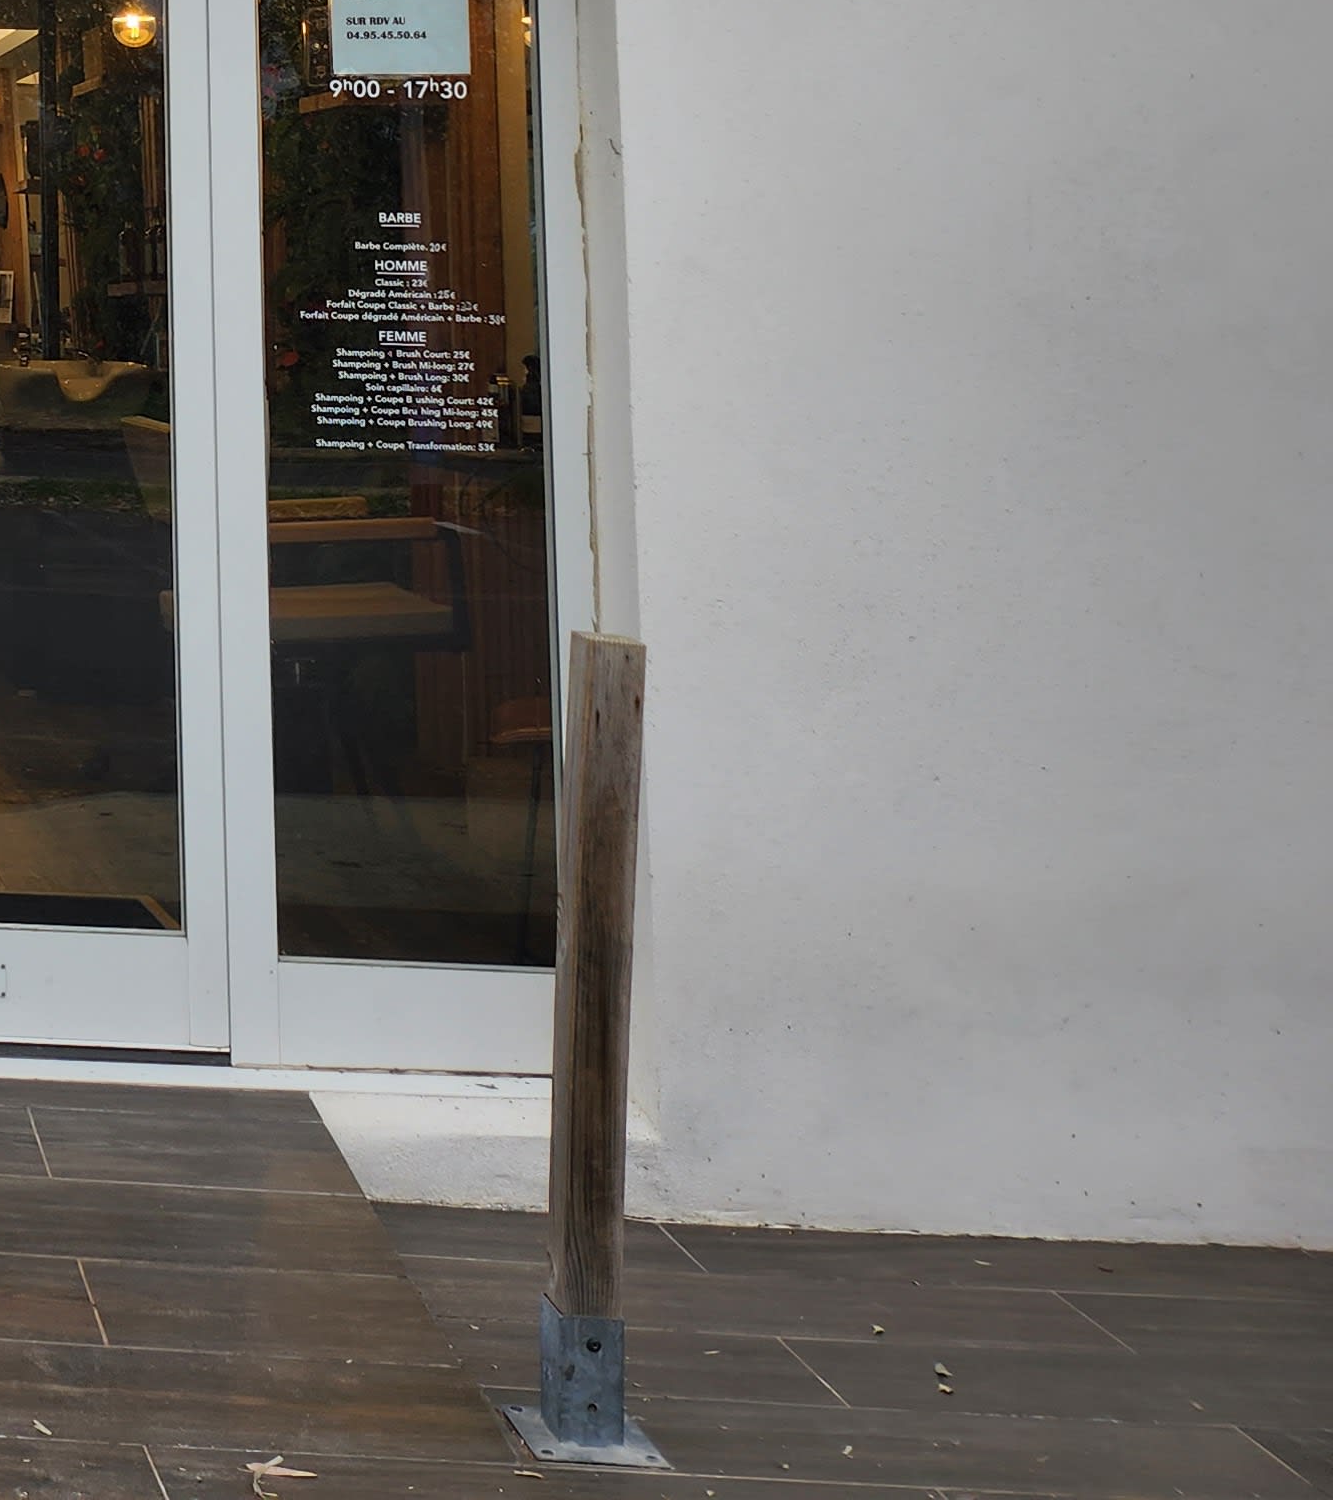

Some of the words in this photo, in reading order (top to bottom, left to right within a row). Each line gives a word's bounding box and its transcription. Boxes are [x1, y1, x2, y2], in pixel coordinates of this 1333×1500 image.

[346, 17, 366, 25] SUR
[369, 17, 390, 25] RDV
[392, 17, 405, 25] AU
[346, 31, 426, 39] 04.95.45.50.64
[329, 80, 380, 98] 9h00
[403, 79, 467, 99] 17h30
[378, 212, 421, 224] BARBE
[354, 242, 380, 250] Barbe
[375, 260, 428, 271] HOMME
[375, 279, 404, 287] Classic
[348, 289, 386, 299] Dégradé
[388, 291, 432, 299] Américain
[326, 300, 355, 308] Forfait
[357, 301, 386, 310] Coupe
[388, 301, 417, 310] Classic
[429, 302, 454, 310] Barbe
[300, 311, 329, 319] Forfait
[331, 312, 359, 321] Coupe
[362, 312, 398, 322] dégradé
[401, 313, 444, 321] Américain
[455, 314, 482, 322] Barbe
[378, 331, 427, 342] FEMME
[336, 348, 385, 359] Shampoing
[423, 350, 451, 358] Court:
[453, 351, 470, 359] 25€
[333, 360, 381, 370] Shampoing
[392, 361, 417, 369] Brush
[458, 362, 475, 370] 27€
[338, 371, 387, 381] Shampoing
[398, 372, 423, 380] Brush
[425, 373, 450, 383] Long:
[452, 373, 469, 382] 30€
[365, 383, 385, 391] Soin
[387, 384, 429, 393] capillaire:
[315, 393, 364, 404] Shampoing
[375, 395, 404, 405] Coupe
[447, 396, 475, 405] Court:
[477, 397, 494, 405] 42€
[311, 405, 360, 415] Shampoing
[371, 406, 400, 416] Coupe
[481, 409, 499, 417] 45€
[317, 416, 366, 427] Shampoing
[377, 418, 406, 428] Coupe
[408, 419, 446, 429] Brushing
[449, 420, 474, 429] Long:
[316, 439, 365, 450] Shampoing
[376, 440, 405, 451] Coupe
[406, 441, 476, 451] Transformation:
[478, 443, 495, 451] 53€
